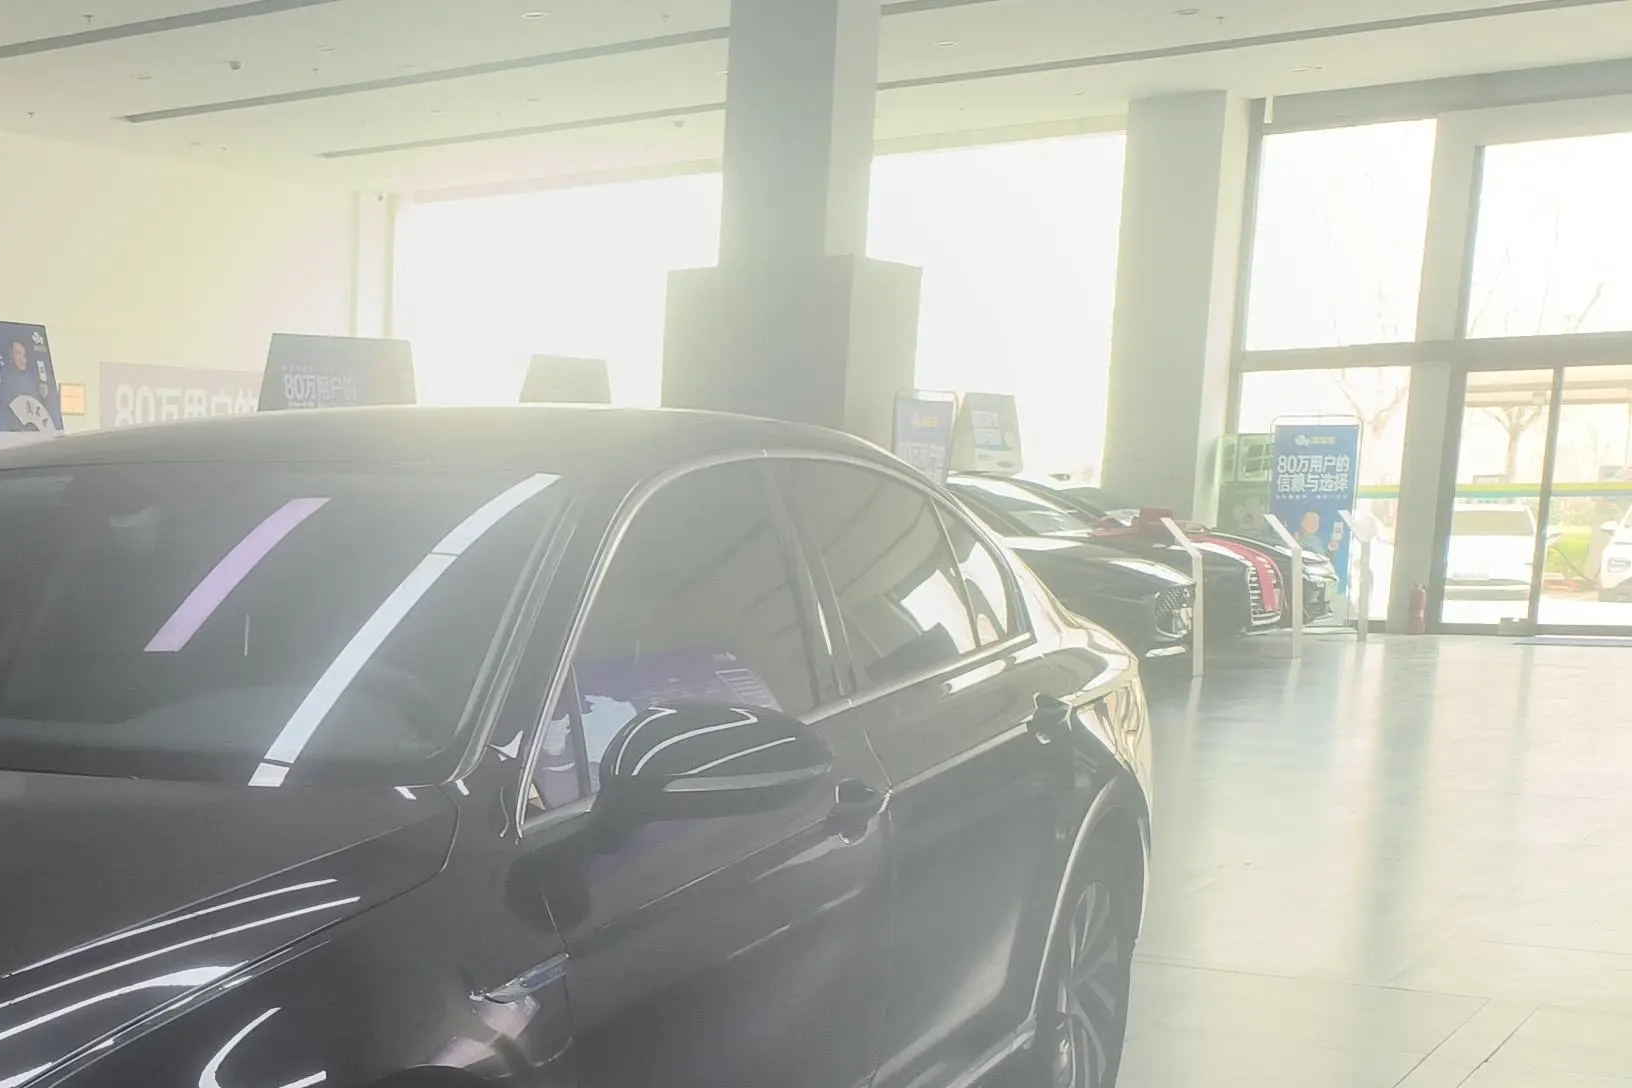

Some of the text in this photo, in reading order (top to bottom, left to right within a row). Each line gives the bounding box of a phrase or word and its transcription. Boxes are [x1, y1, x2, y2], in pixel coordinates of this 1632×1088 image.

[1277, 453, 1350, 474] 80万用户的
[1277, 472, 1349, 493] 信赖与选择
